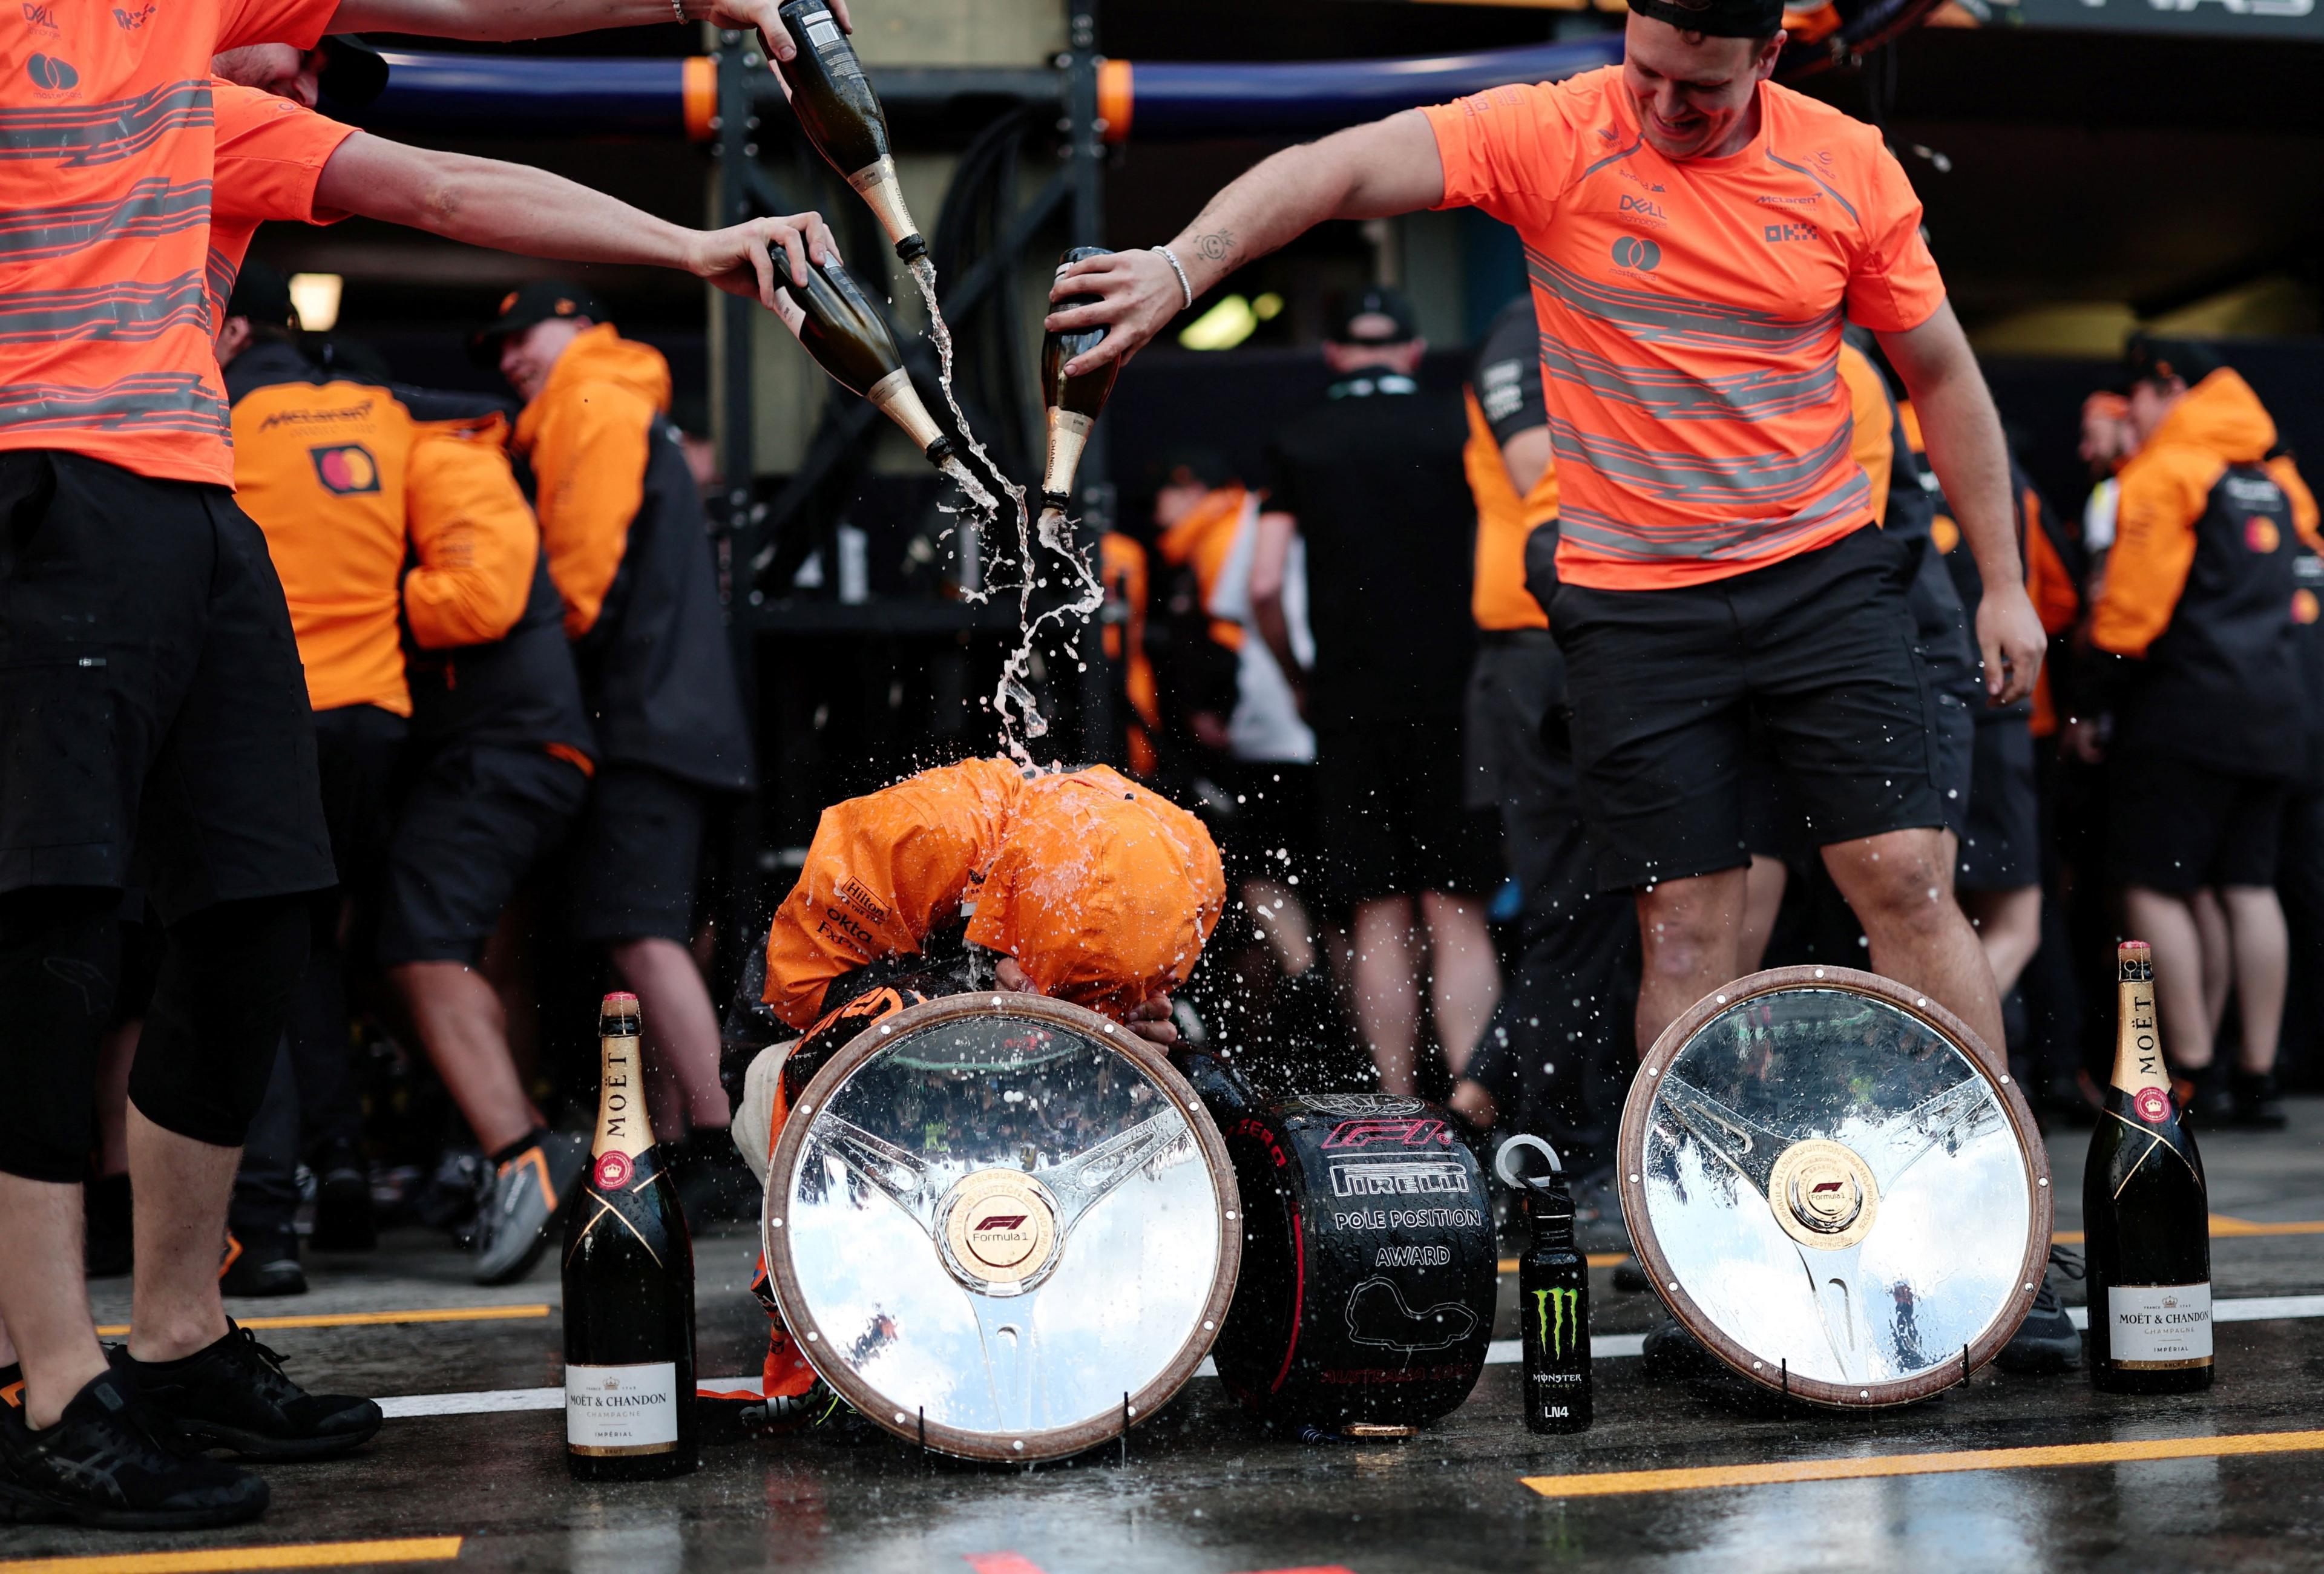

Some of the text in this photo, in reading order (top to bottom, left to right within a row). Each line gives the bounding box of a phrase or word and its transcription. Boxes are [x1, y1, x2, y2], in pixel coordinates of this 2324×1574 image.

[22, 3, 59, 29] DELL
[895, 188, 914, 227] CHANDON
[1620, 194, 1667, 219] DELL
[1755, 195, 1816, 204] McLaren
[1617, 212, 1667, 229] Technologies
[1765, 223, 1817, 242] OKX
[1609, 268, 1656, 281] mastercard
[1047, 439, 1057, 479] CHANDON
[847, 882, 884, 916] Hilton
[851, 905, 865, 916] THE
[827, 908, 873, 943] okta
[2132, 996, 2157, 1074] MOËT
[605, 1052, 627, 1138] MOËT
[1799, 1144, 1842, 1156] VUITTON
[1781, 1152, 1800, 1174] LOUIS
[1843, 1153, 1869, 1182] GRAND
[968, 1173, 1027, 1186] MELBOURNE
[1329, 1162, 1469, 1196] PIRELLI
[1776, 1182, 1797, 1229] FORMULA
[1866, 1183, 1874, 1207] PRIX
[1023, 1194, 1048, 1227] GRAND
[1037, 1230, 1049, 1255] PRIX
[1334, 1209, 1482, 1230] POLE POSITION
[1859, 1208, 1873, 1230] 2025
[1376, 1246, 1451, 1267] AWARD
[2119, 1310, 2209, 1324] MOËT & CHANDON
[2144, 1326, 2195, 1335] CHAMPAGNE
[1321, 1368, 1426, 1384] AUSTRALIA
[1533, 1372, 1582, 1383] MONSTER
[570, 1392, 666, 1407] MOËT & CHANDON
[1544, 1406, 1569, 1418] LN4
